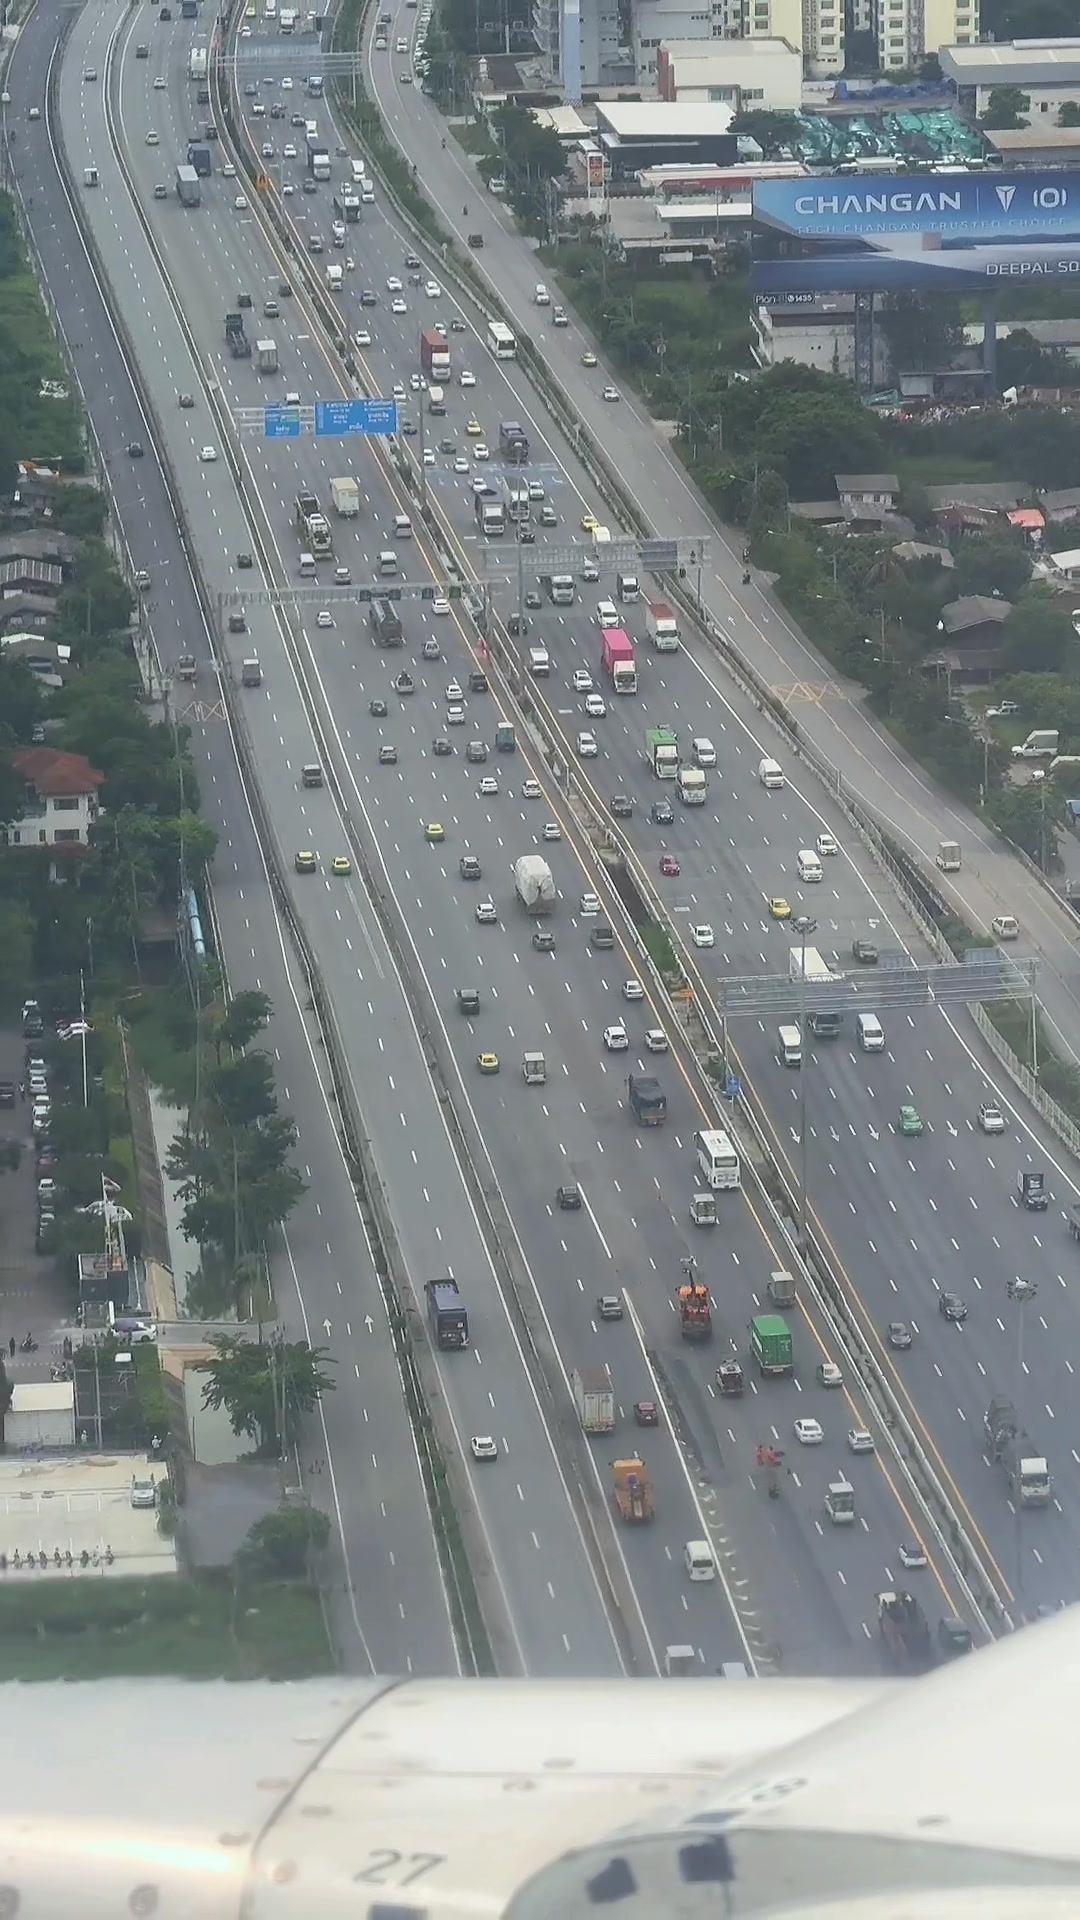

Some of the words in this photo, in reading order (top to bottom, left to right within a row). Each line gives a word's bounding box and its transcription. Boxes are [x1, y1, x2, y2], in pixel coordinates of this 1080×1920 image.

[795, 191, 961, 215] CHANGAN
[844, 222, 920, 233] CHANGAN
[930, 219, 1000, 231] TRUSTED
[1009, 217, 1065, 228] CHOICE
[986, 261, 1054, 276] DEEPAL
[1058, 260, 1080, 273] S0
[352, 1847, 449, 1887] 27
